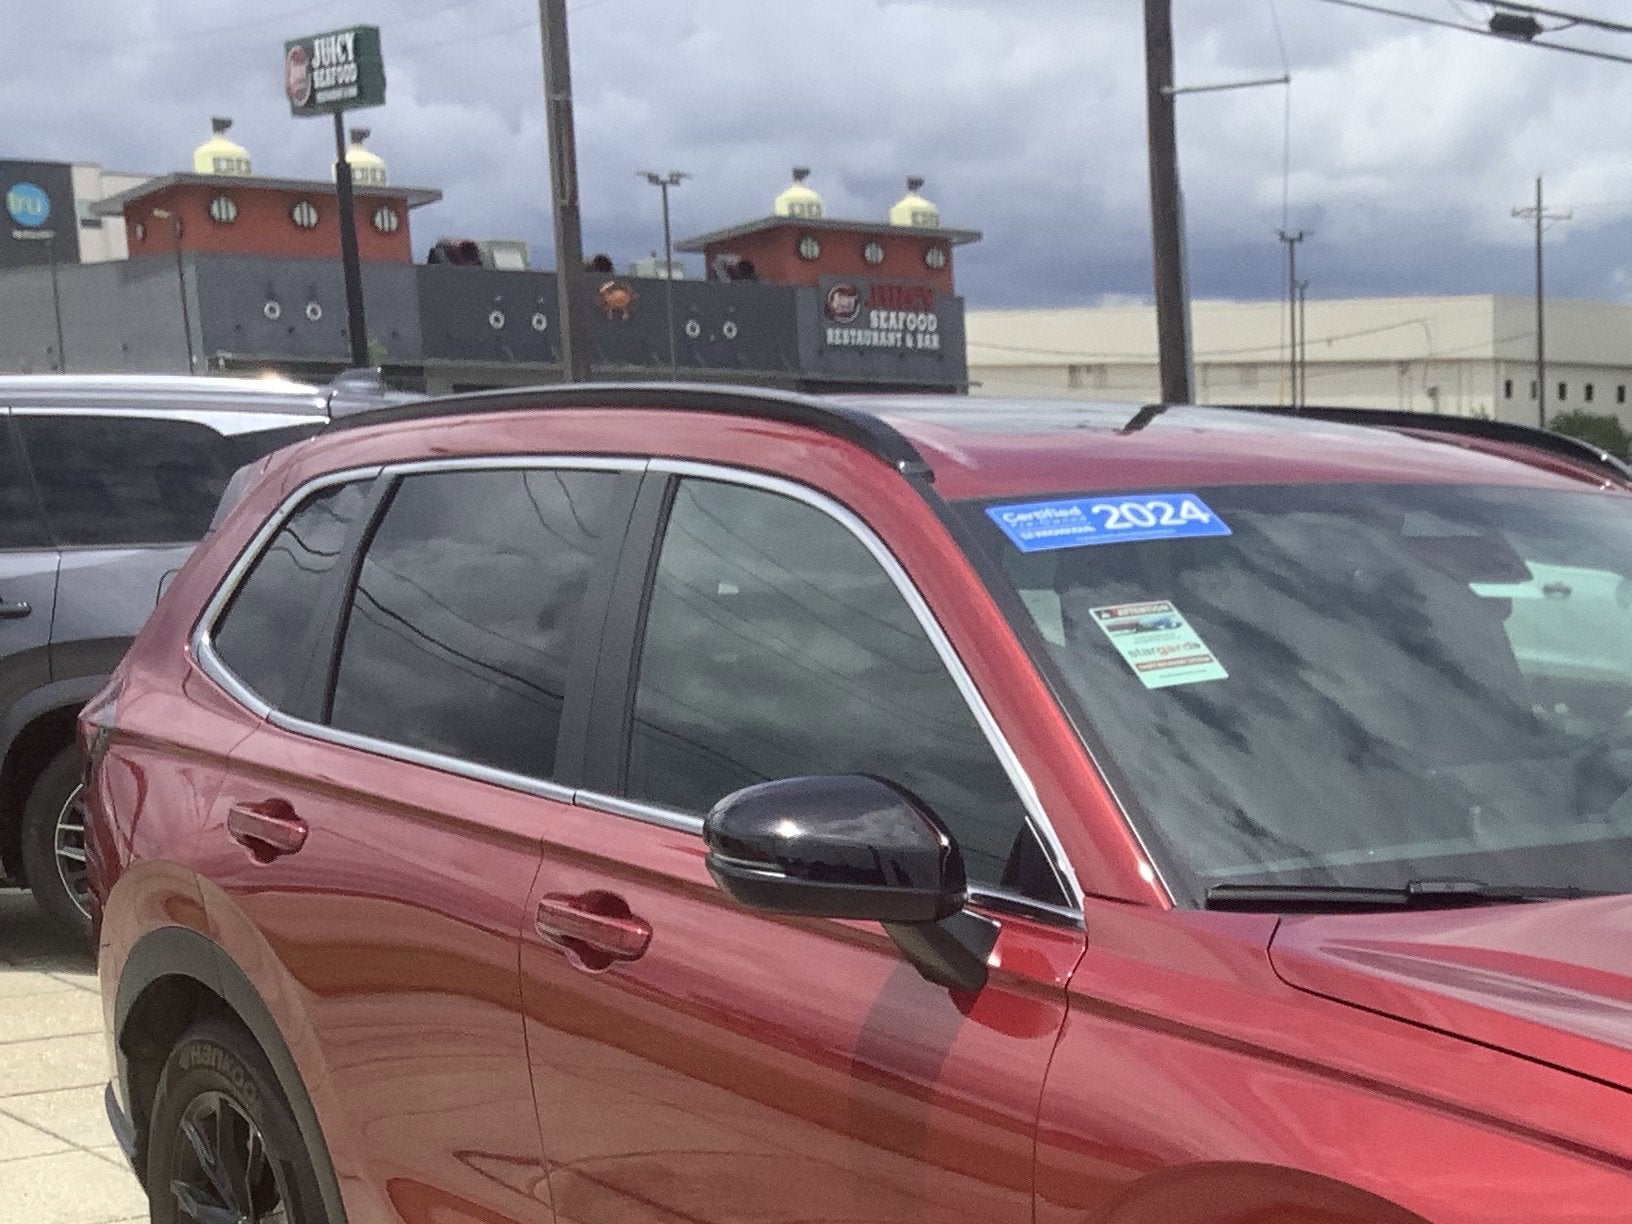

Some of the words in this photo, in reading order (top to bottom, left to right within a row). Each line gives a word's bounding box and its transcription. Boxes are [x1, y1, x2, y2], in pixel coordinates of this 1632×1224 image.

[312, 31, 354, 69] JUICY
[313, 63, 358, 90] SEAFOOD
[869, 310, 938, 332] SEAFOOD
[826, 328, 902, 347] RESTAURANT
[1003, 505, 1082, 524] Certified
[1092, 500, 1211, 530] 2024
